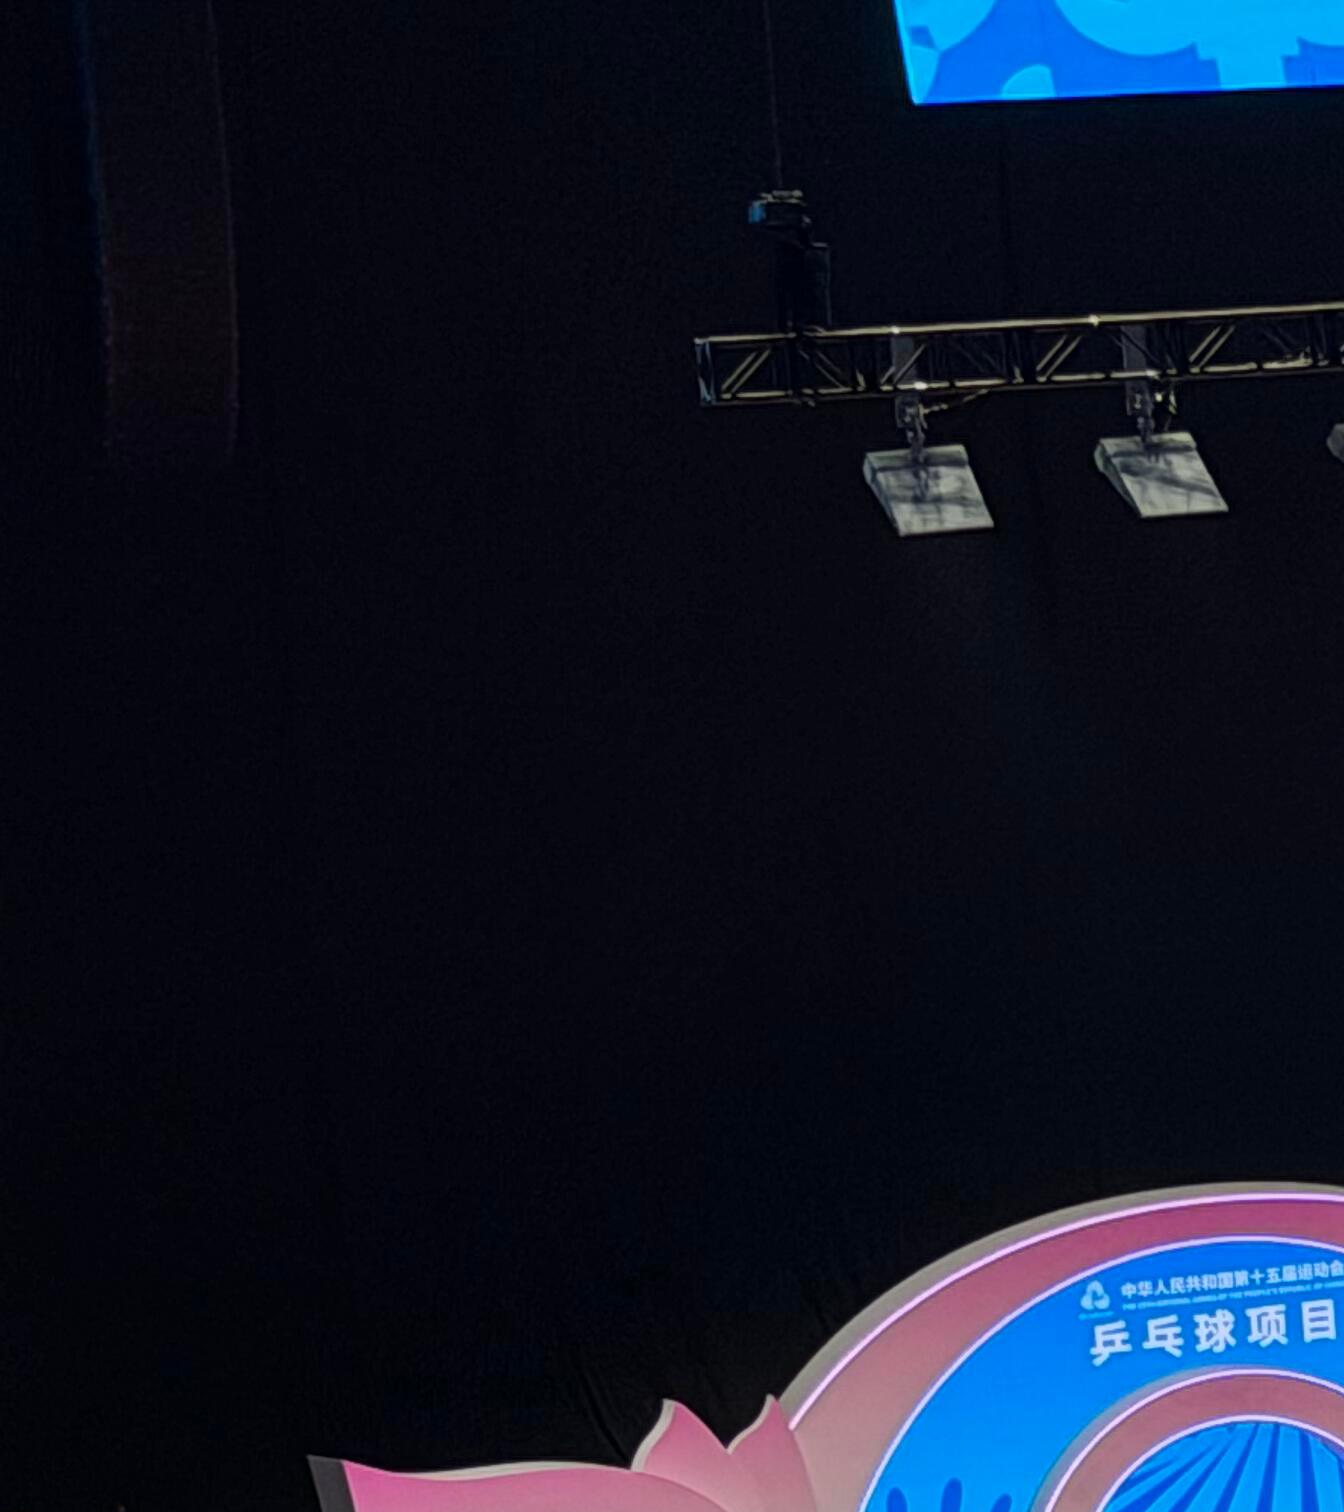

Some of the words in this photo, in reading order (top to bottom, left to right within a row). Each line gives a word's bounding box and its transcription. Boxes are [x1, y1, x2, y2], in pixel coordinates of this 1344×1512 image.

[1090, 1299, 1337, 1367] 乒乓球项目
